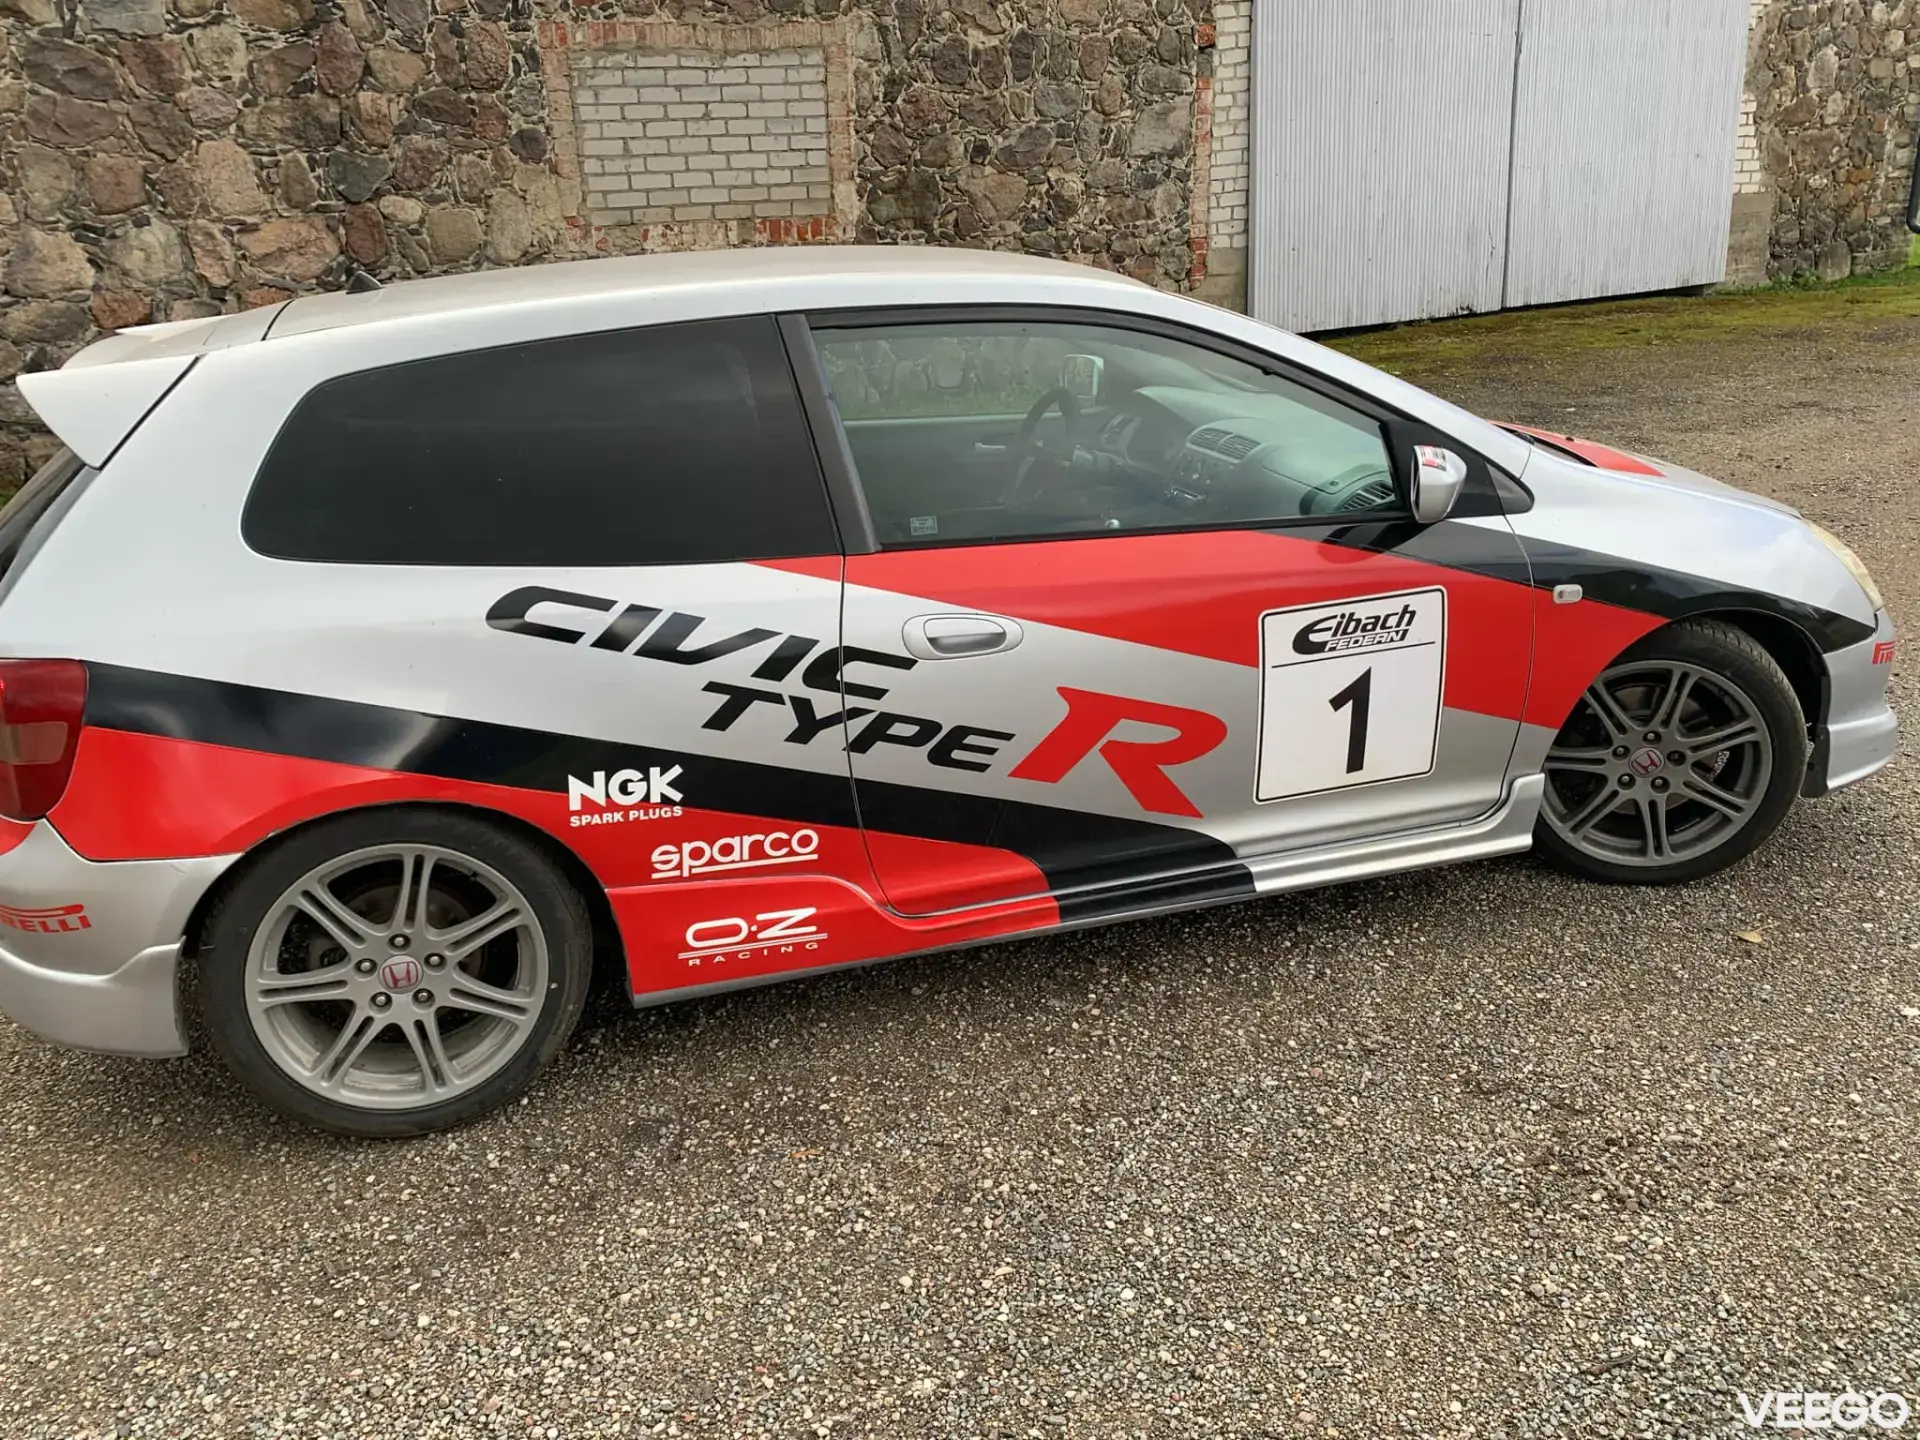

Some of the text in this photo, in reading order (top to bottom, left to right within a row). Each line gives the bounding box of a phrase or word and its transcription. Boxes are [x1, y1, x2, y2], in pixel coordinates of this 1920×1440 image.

[485, 586, 919, 700] CIVIC
[1292, 604, 1416, 655] Eibach
[1324, 630, 1409, 652] FEDERN
[1329, 666, 1372, 774] 1
[701, 681, 1228, 818] TYPE R
[568, 764, 684, 811] NGK
[569, 805, 683, 827] SPARK PLUGS
[651, 828, 819, 877] sparco
[688, 942, 819, 967] RACING
